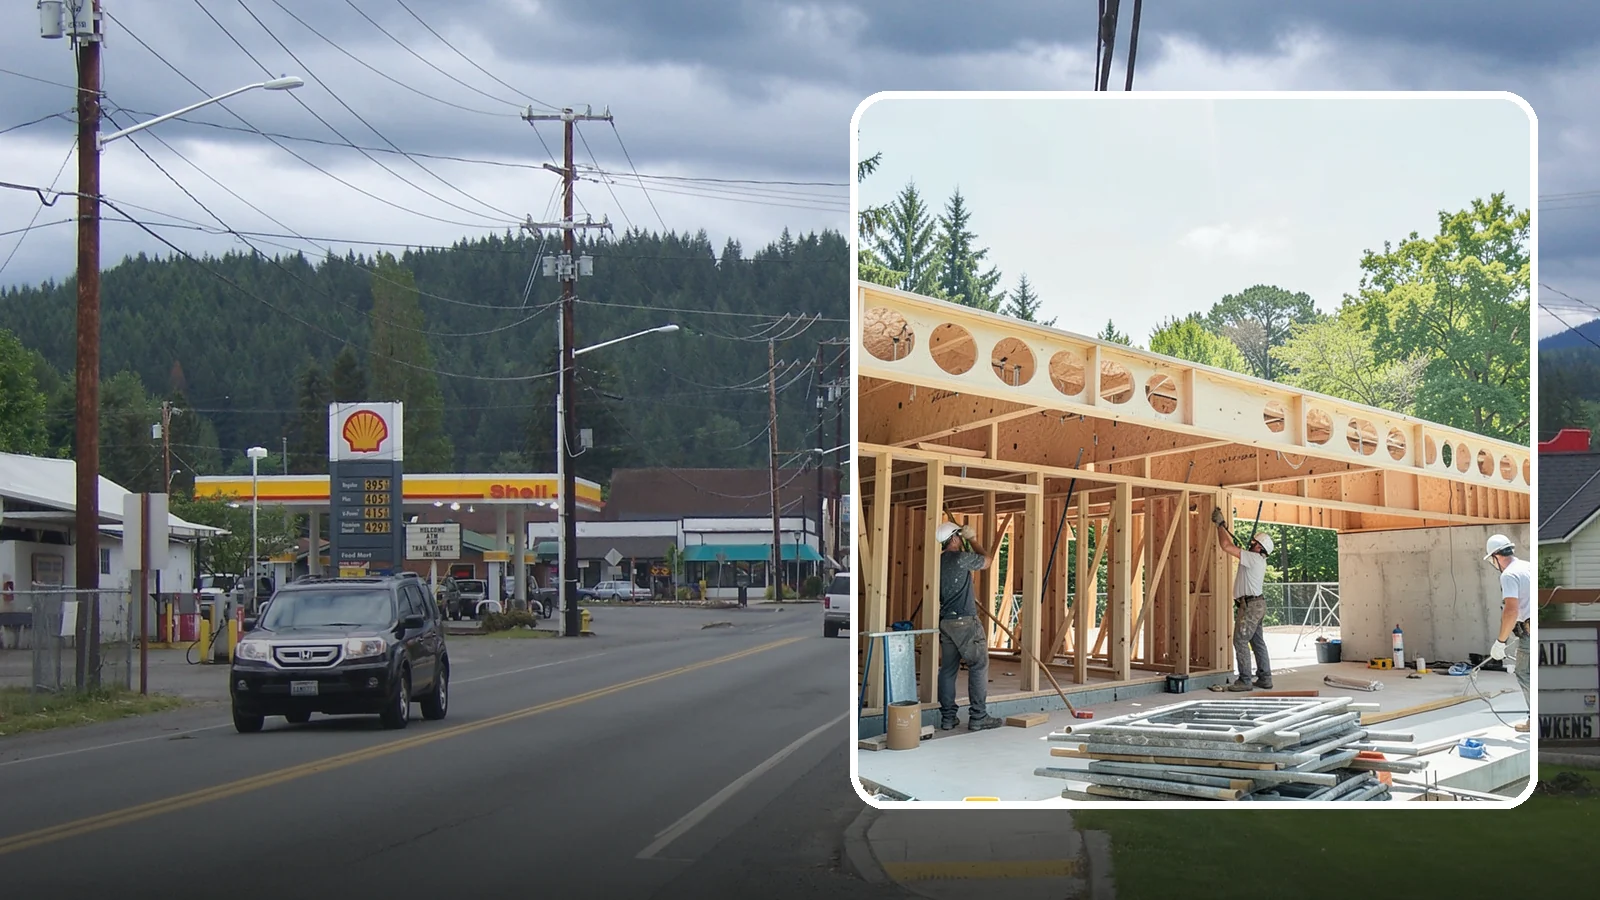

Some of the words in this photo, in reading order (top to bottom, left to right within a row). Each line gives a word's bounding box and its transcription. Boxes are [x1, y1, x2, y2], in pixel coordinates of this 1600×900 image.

[365, 480, 384, 490] 395
[490, 484, 548, 499] Shell
[365, 494, 384, 504] 405
[365, 508, 384, 518] 415
[365, 522, 384, 532] 429
[1538, 642, 1567, 666] AID
